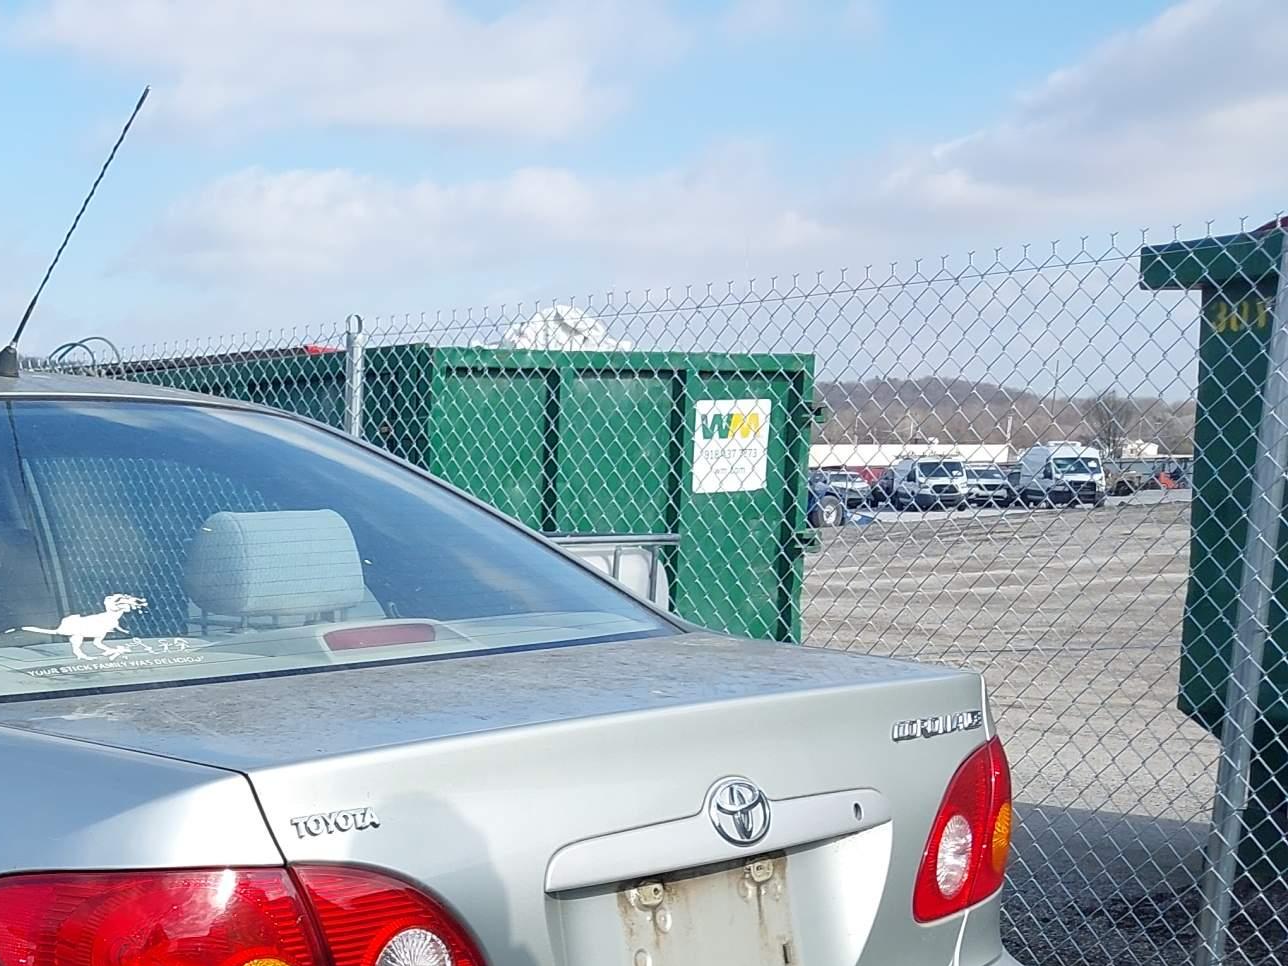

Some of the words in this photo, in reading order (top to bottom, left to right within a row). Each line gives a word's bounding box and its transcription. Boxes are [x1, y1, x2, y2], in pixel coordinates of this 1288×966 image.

[701, 412, 760, 440] WM
[27, 667, 60, 677] YOUR
[59, 664, 93, 674] STICK
[290, 807, 381, 839] TOYOTA
